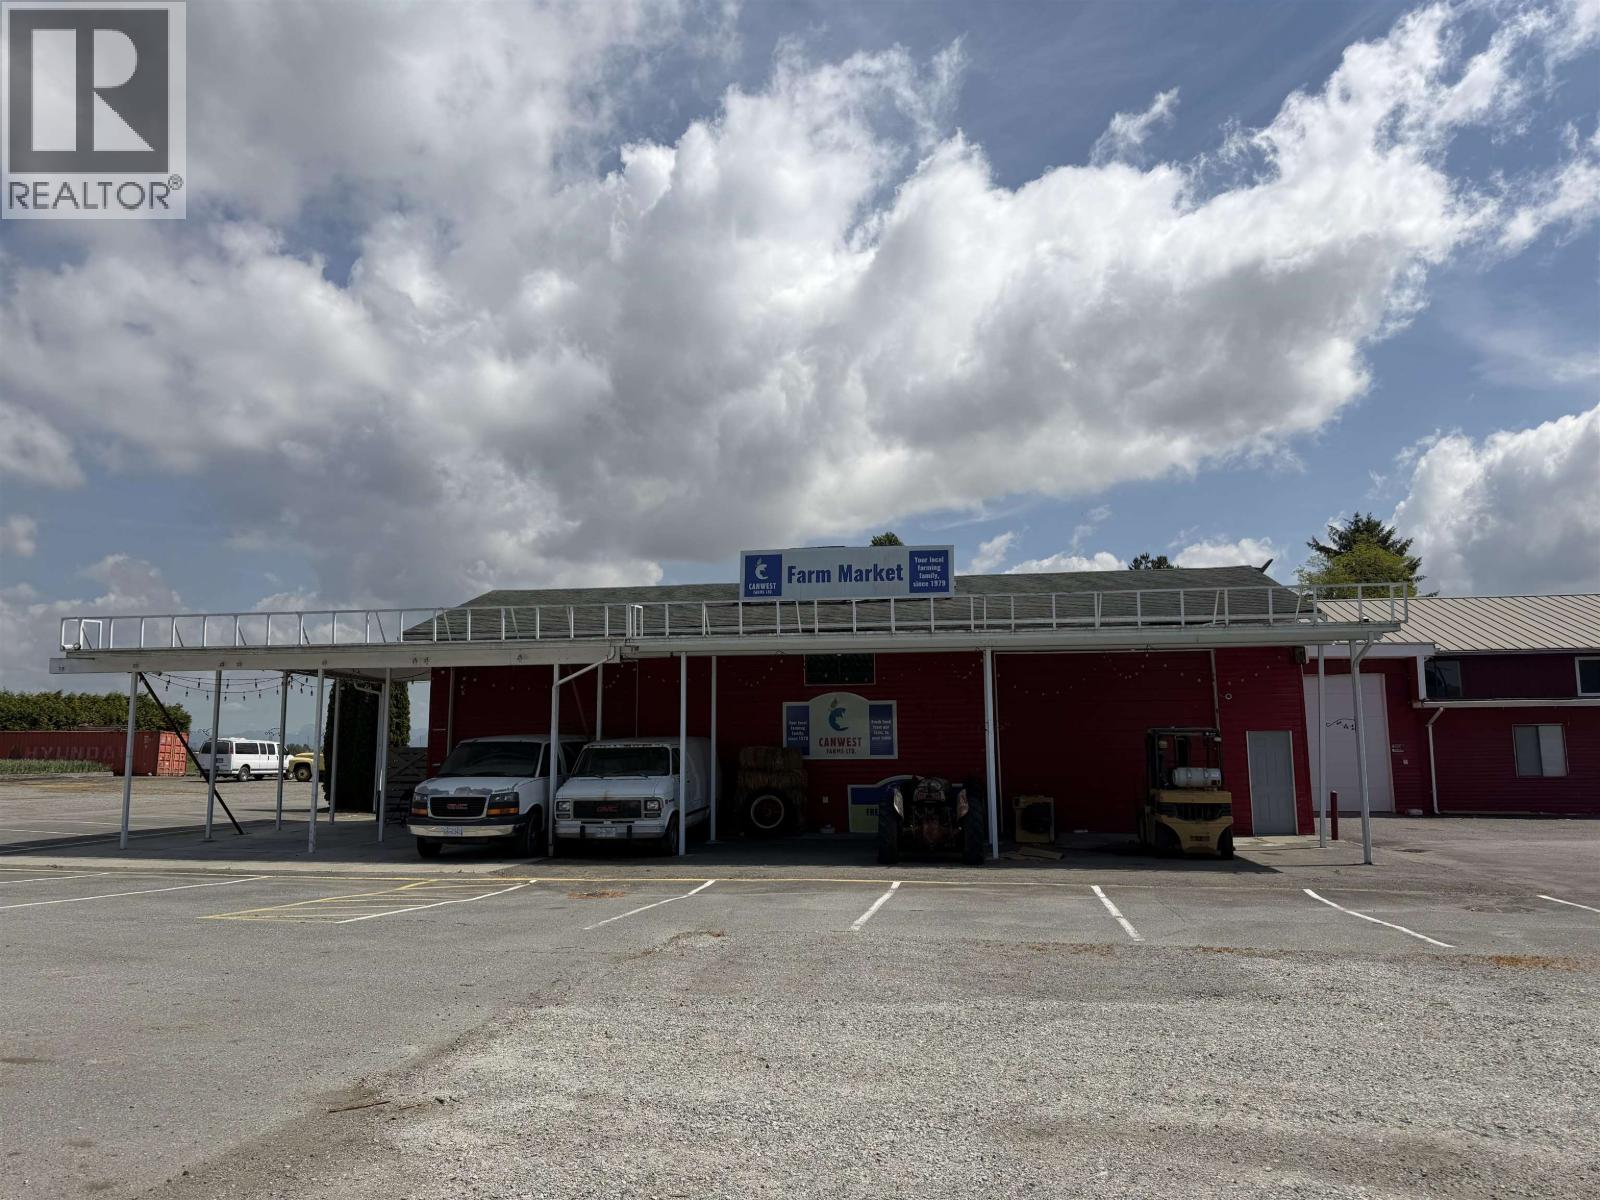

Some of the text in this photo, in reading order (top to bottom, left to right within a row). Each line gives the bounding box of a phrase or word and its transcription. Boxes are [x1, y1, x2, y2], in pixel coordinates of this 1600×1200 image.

[914, 556, 928, 564] Your
[917, 564, 941, 572] farming
[787, 563, 904, 584] Farm Market
[919, 572, 940, 580] family,
[748, 582, 777, 591] CANWEST
[818, 736, 862, 747] CANWEST
